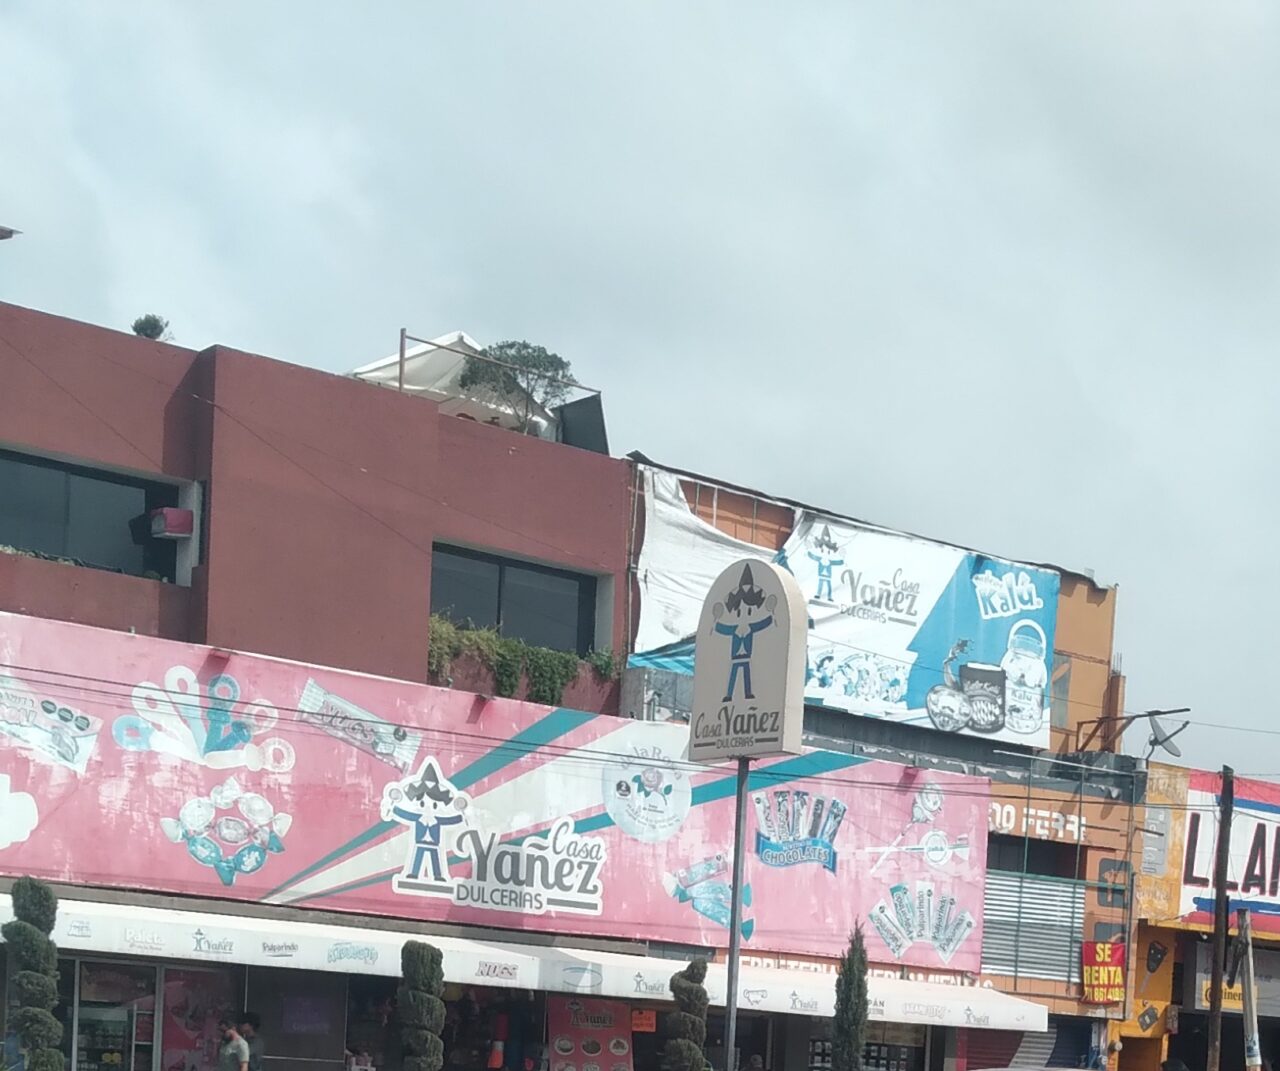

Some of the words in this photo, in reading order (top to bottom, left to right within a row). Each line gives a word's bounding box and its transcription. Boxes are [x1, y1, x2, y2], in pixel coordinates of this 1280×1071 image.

[840, 569, 918, 616] Yañez
[893, 568, 921, 594] Casa
[840, 604, 887, 624] DULCERIAS
[695, 712, 722, 739] Casa
[718, 705, 779, 736] Yañez
[716, 736, 754, 749] DULCERIAS
[552, 821, 603, 861] Casa
[456, 829, 599, 894] Yañez
[762, 846, 829, 865] CHOCOLATES
[456, 883, 543, 910] DULCERIAS
[916, 890, 925, 938] Pulparindo
[1096, 943, 1112, 963] SE
[1084, 966, 1123, 985] RENTA
